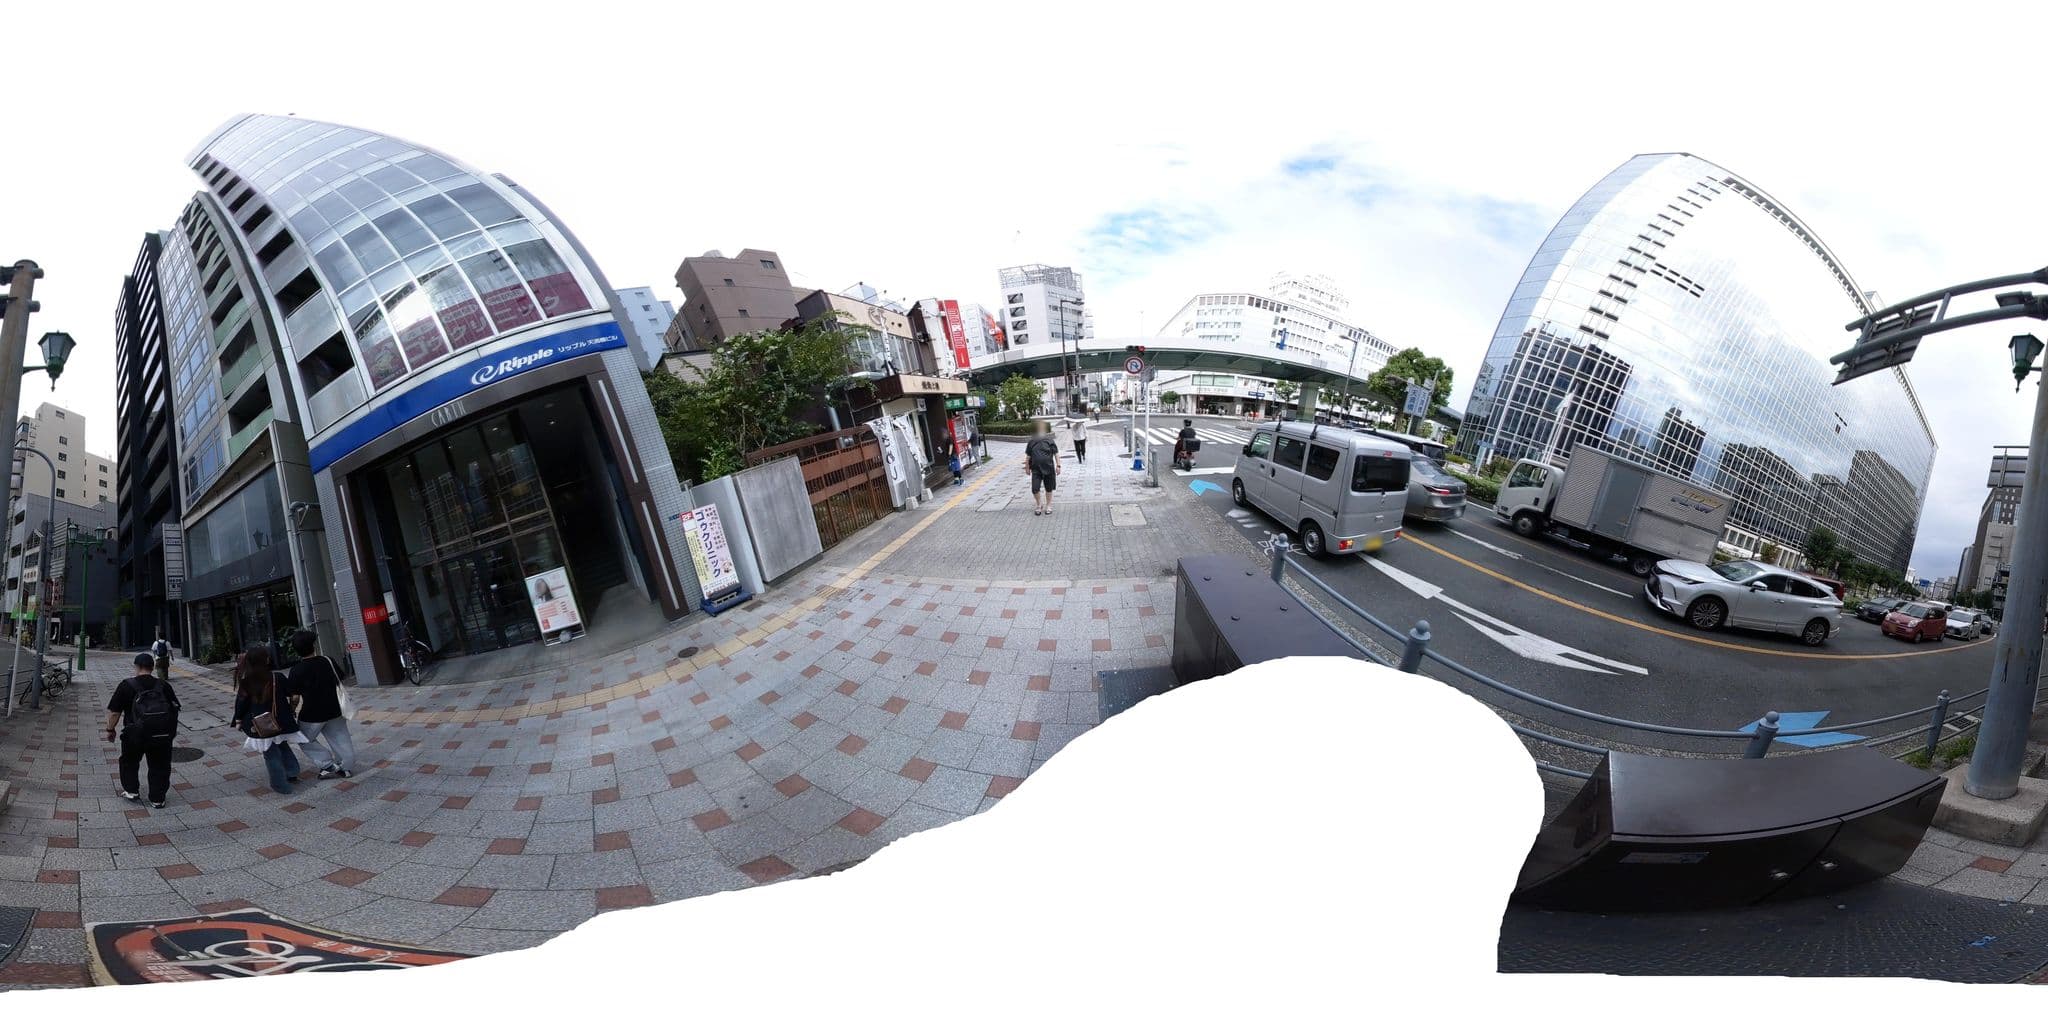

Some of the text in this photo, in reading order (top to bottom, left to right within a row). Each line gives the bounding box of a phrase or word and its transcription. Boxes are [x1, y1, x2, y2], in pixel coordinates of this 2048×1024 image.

[498, 347, 554, 376] Ripple
[695, 511, 722, 578] コウクリニック
